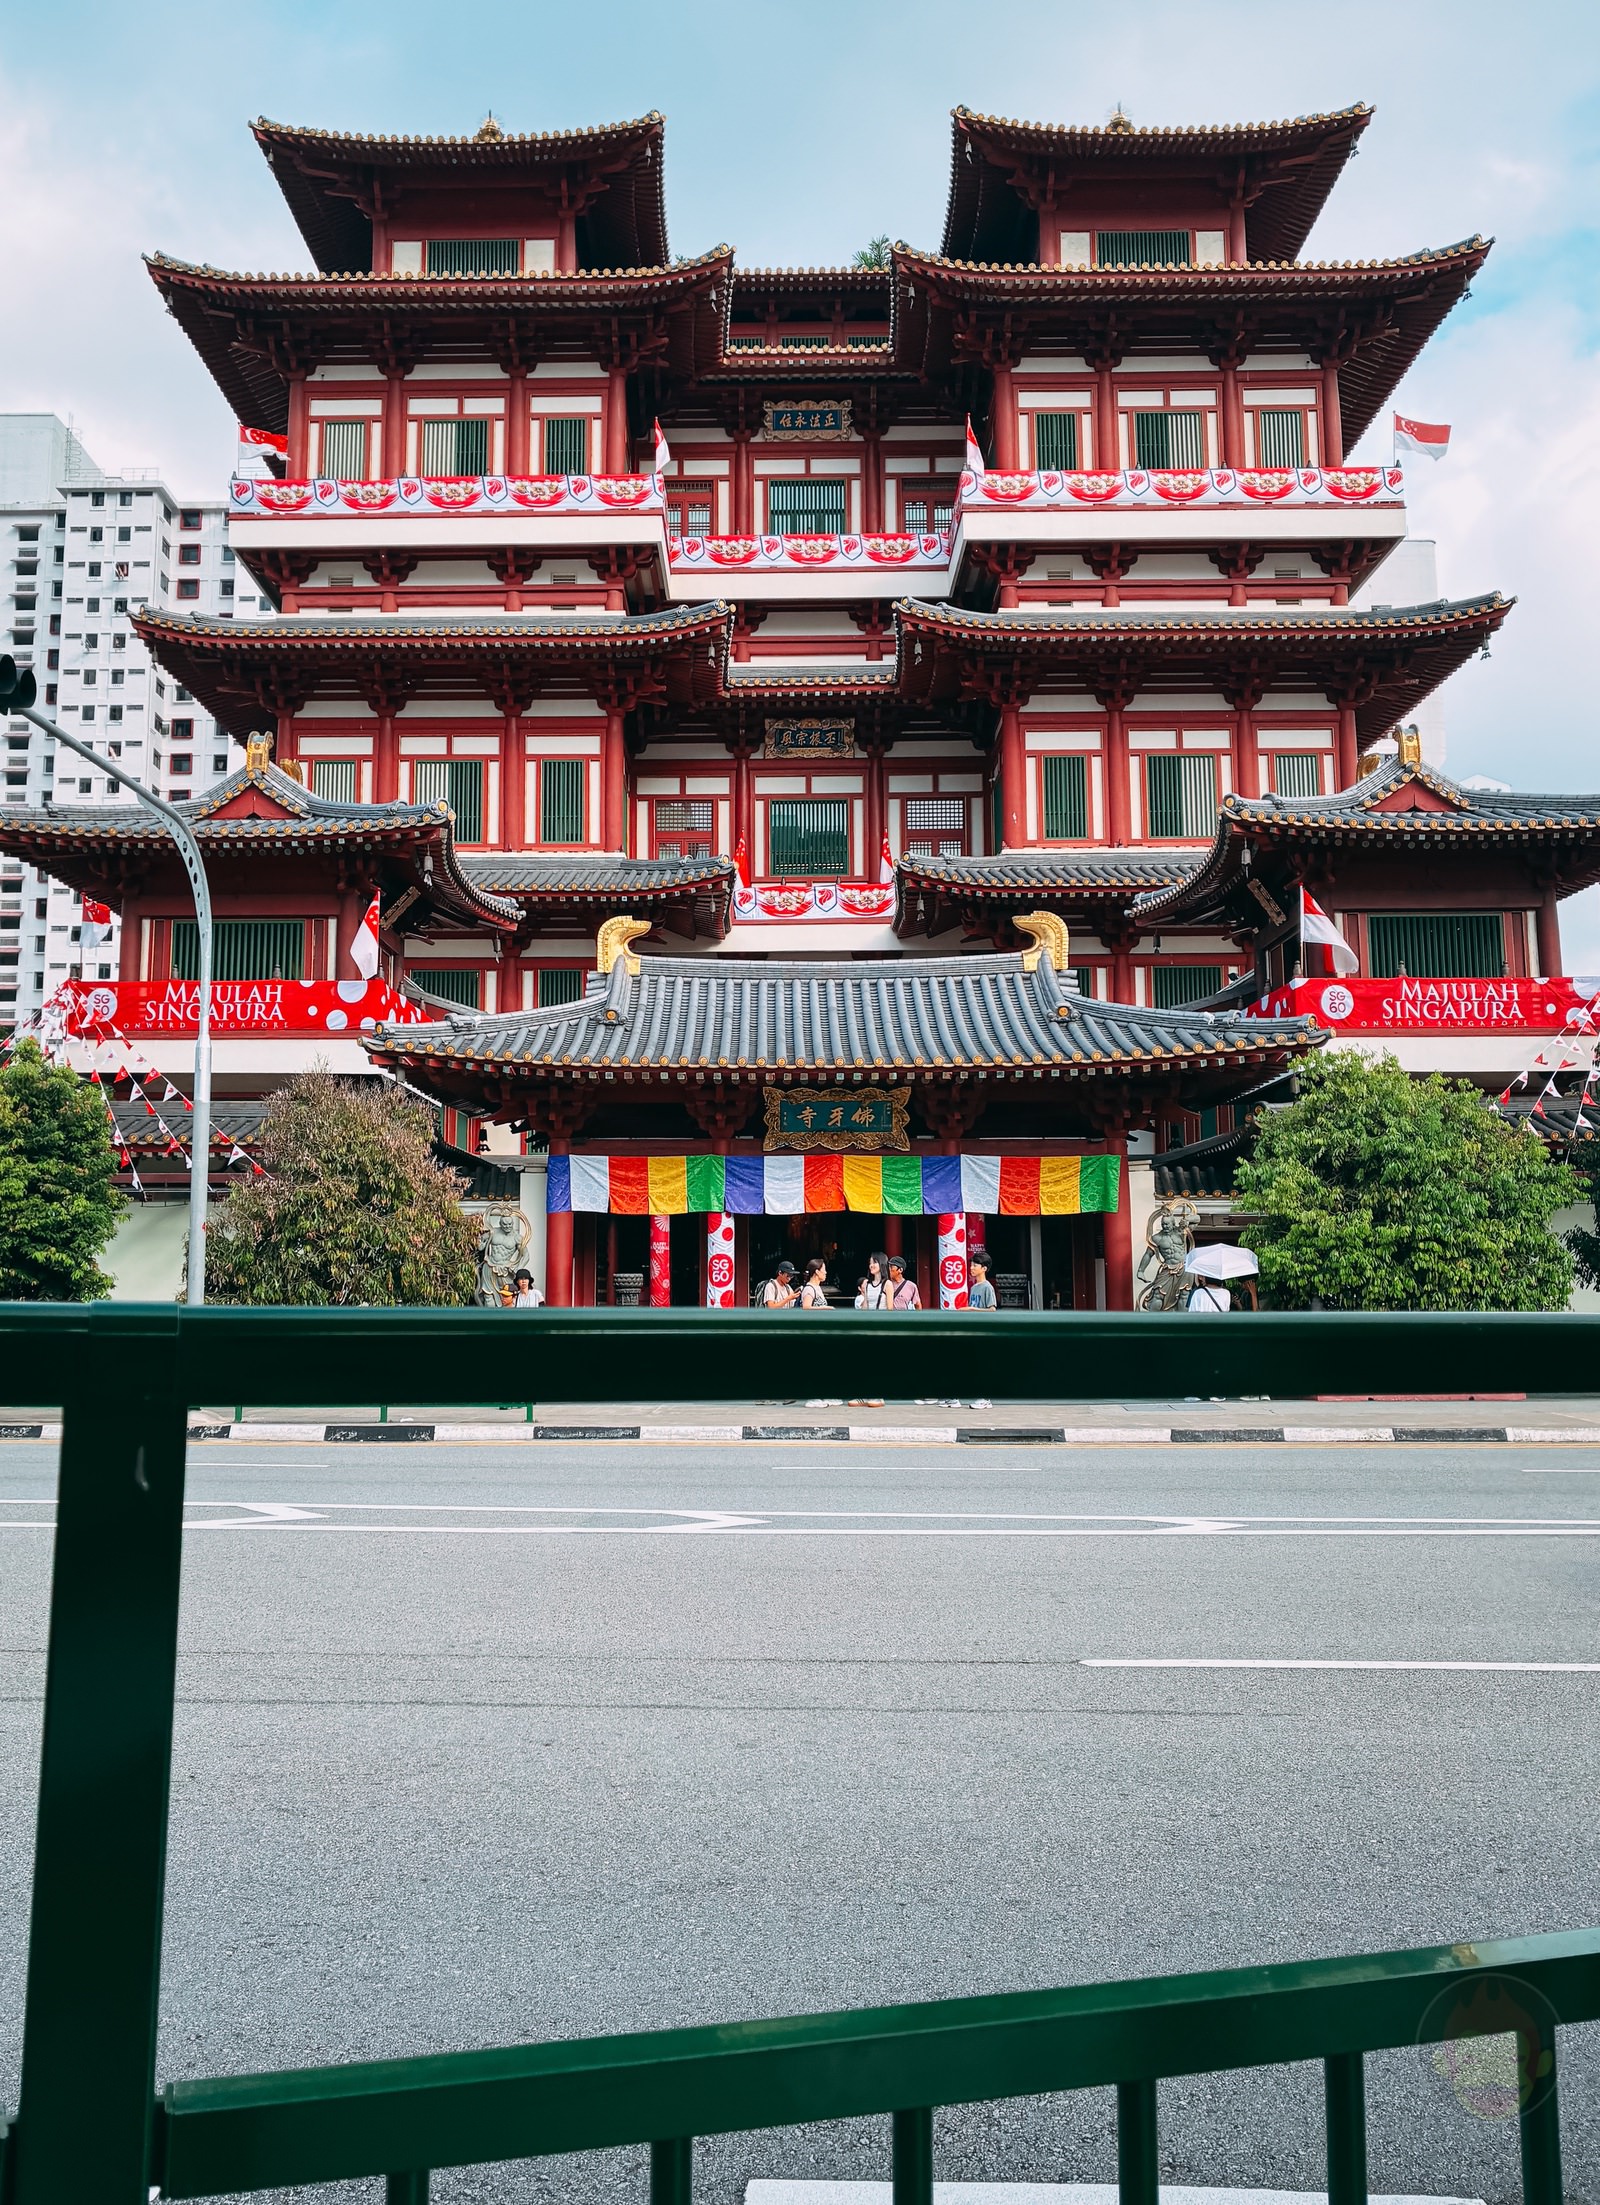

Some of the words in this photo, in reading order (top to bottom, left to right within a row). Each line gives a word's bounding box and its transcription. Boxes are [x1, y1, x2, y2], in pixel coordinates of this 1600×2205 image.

[93, 993, 110, 1005] SG
[1329, 990, 1346, 1002] SG
[1400, 980, 1520, 1007] MAJULAH
[144, 1000, 286, 1021] SINGAPURA
[1329, 1001, 1346, 1014] 60
[1382, 998, 1525, 1020] SINGAPURA
[1360, 1020, 1425, 1028] ONWARD
[712, 1259, 729, 1270] SG
[945, 1260, 963, 1272] SG
[712, 1271, 729, 1283] 60
[945, 1272, 963, 1284] 60
